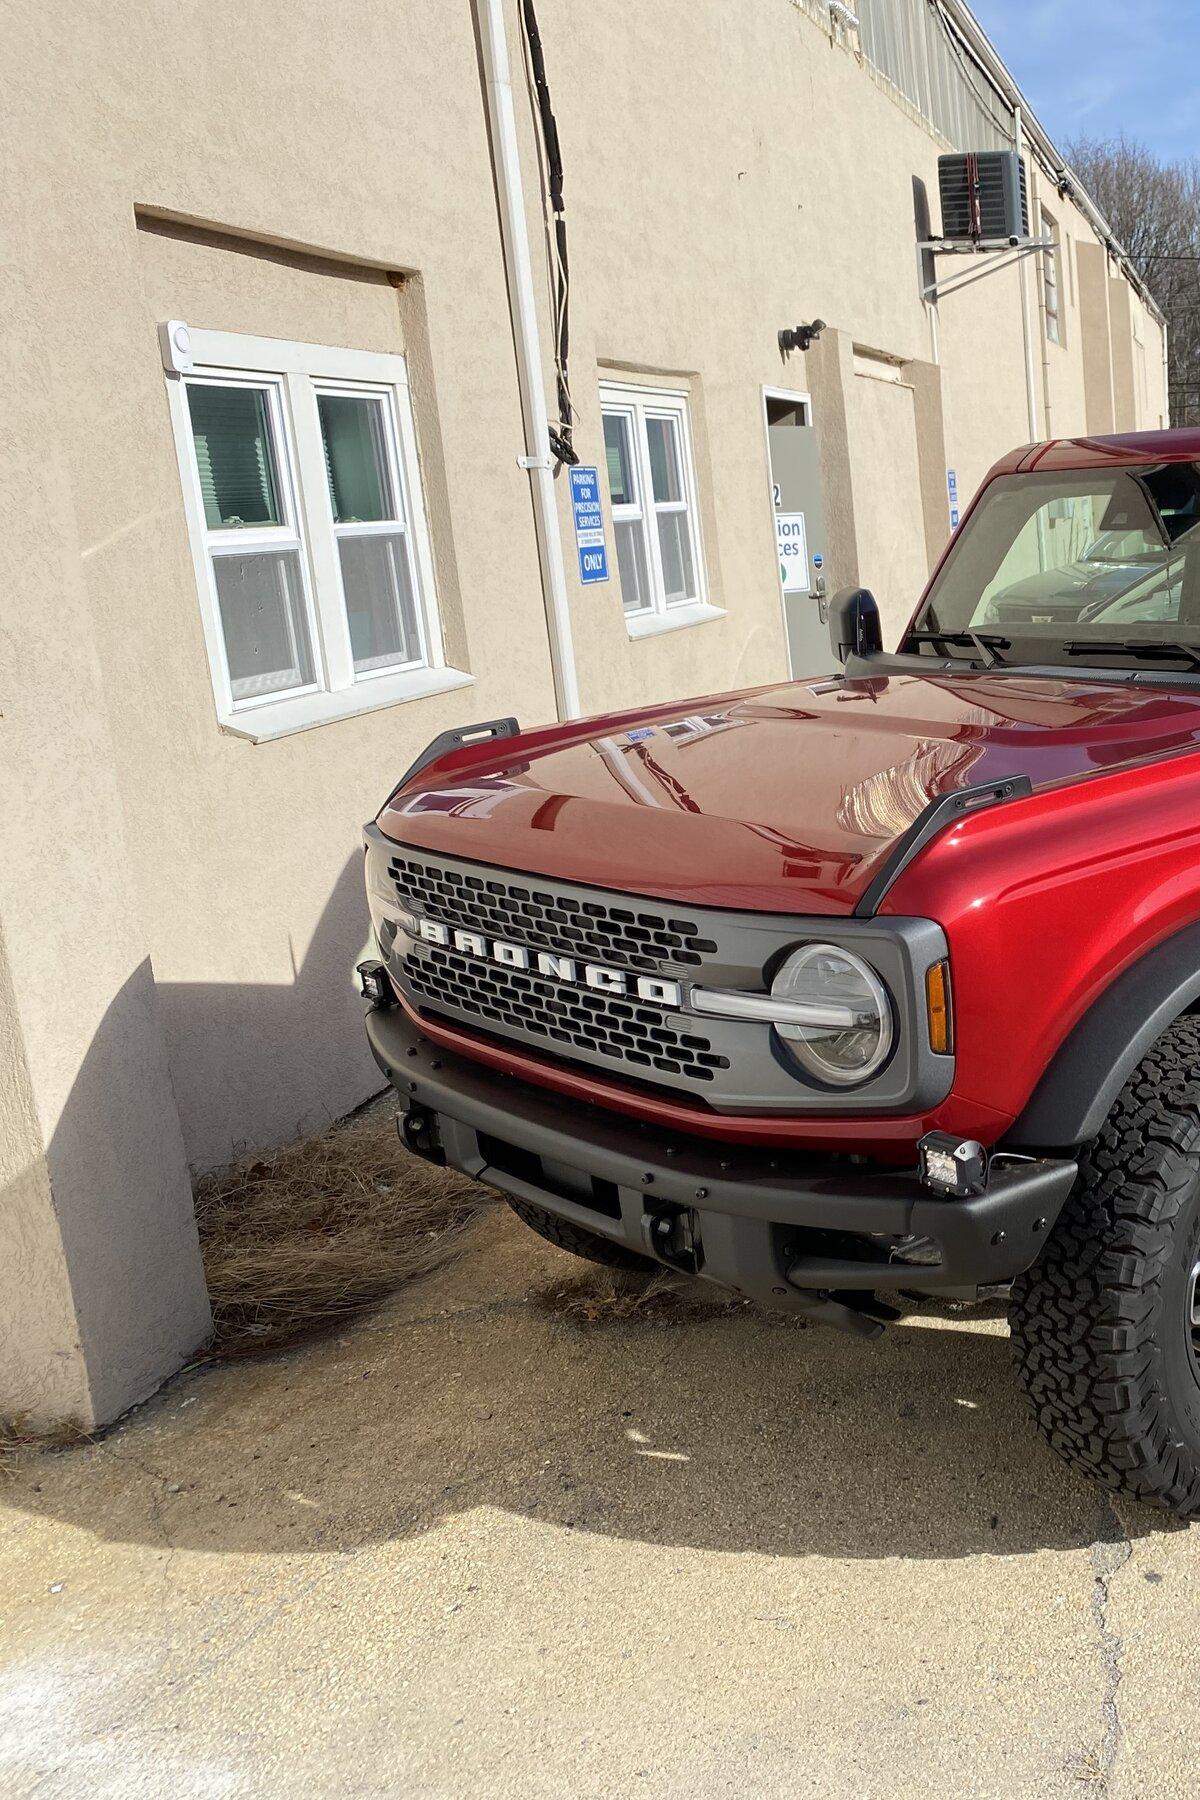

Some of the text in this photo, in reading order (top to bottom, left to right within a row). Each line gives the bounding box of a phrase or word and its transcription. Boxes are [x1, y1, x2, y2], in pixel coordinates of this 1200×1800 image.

[573, 474, 594, 485] PARKING
[581, 488, 591, 499] FOR
[575, 502, 600, 514] PRECISION
[579, 515, 600, 527] SERVICES
[584, 554, 602, 570] ONLY
[420, 919, 682, 1006] BRONCO
